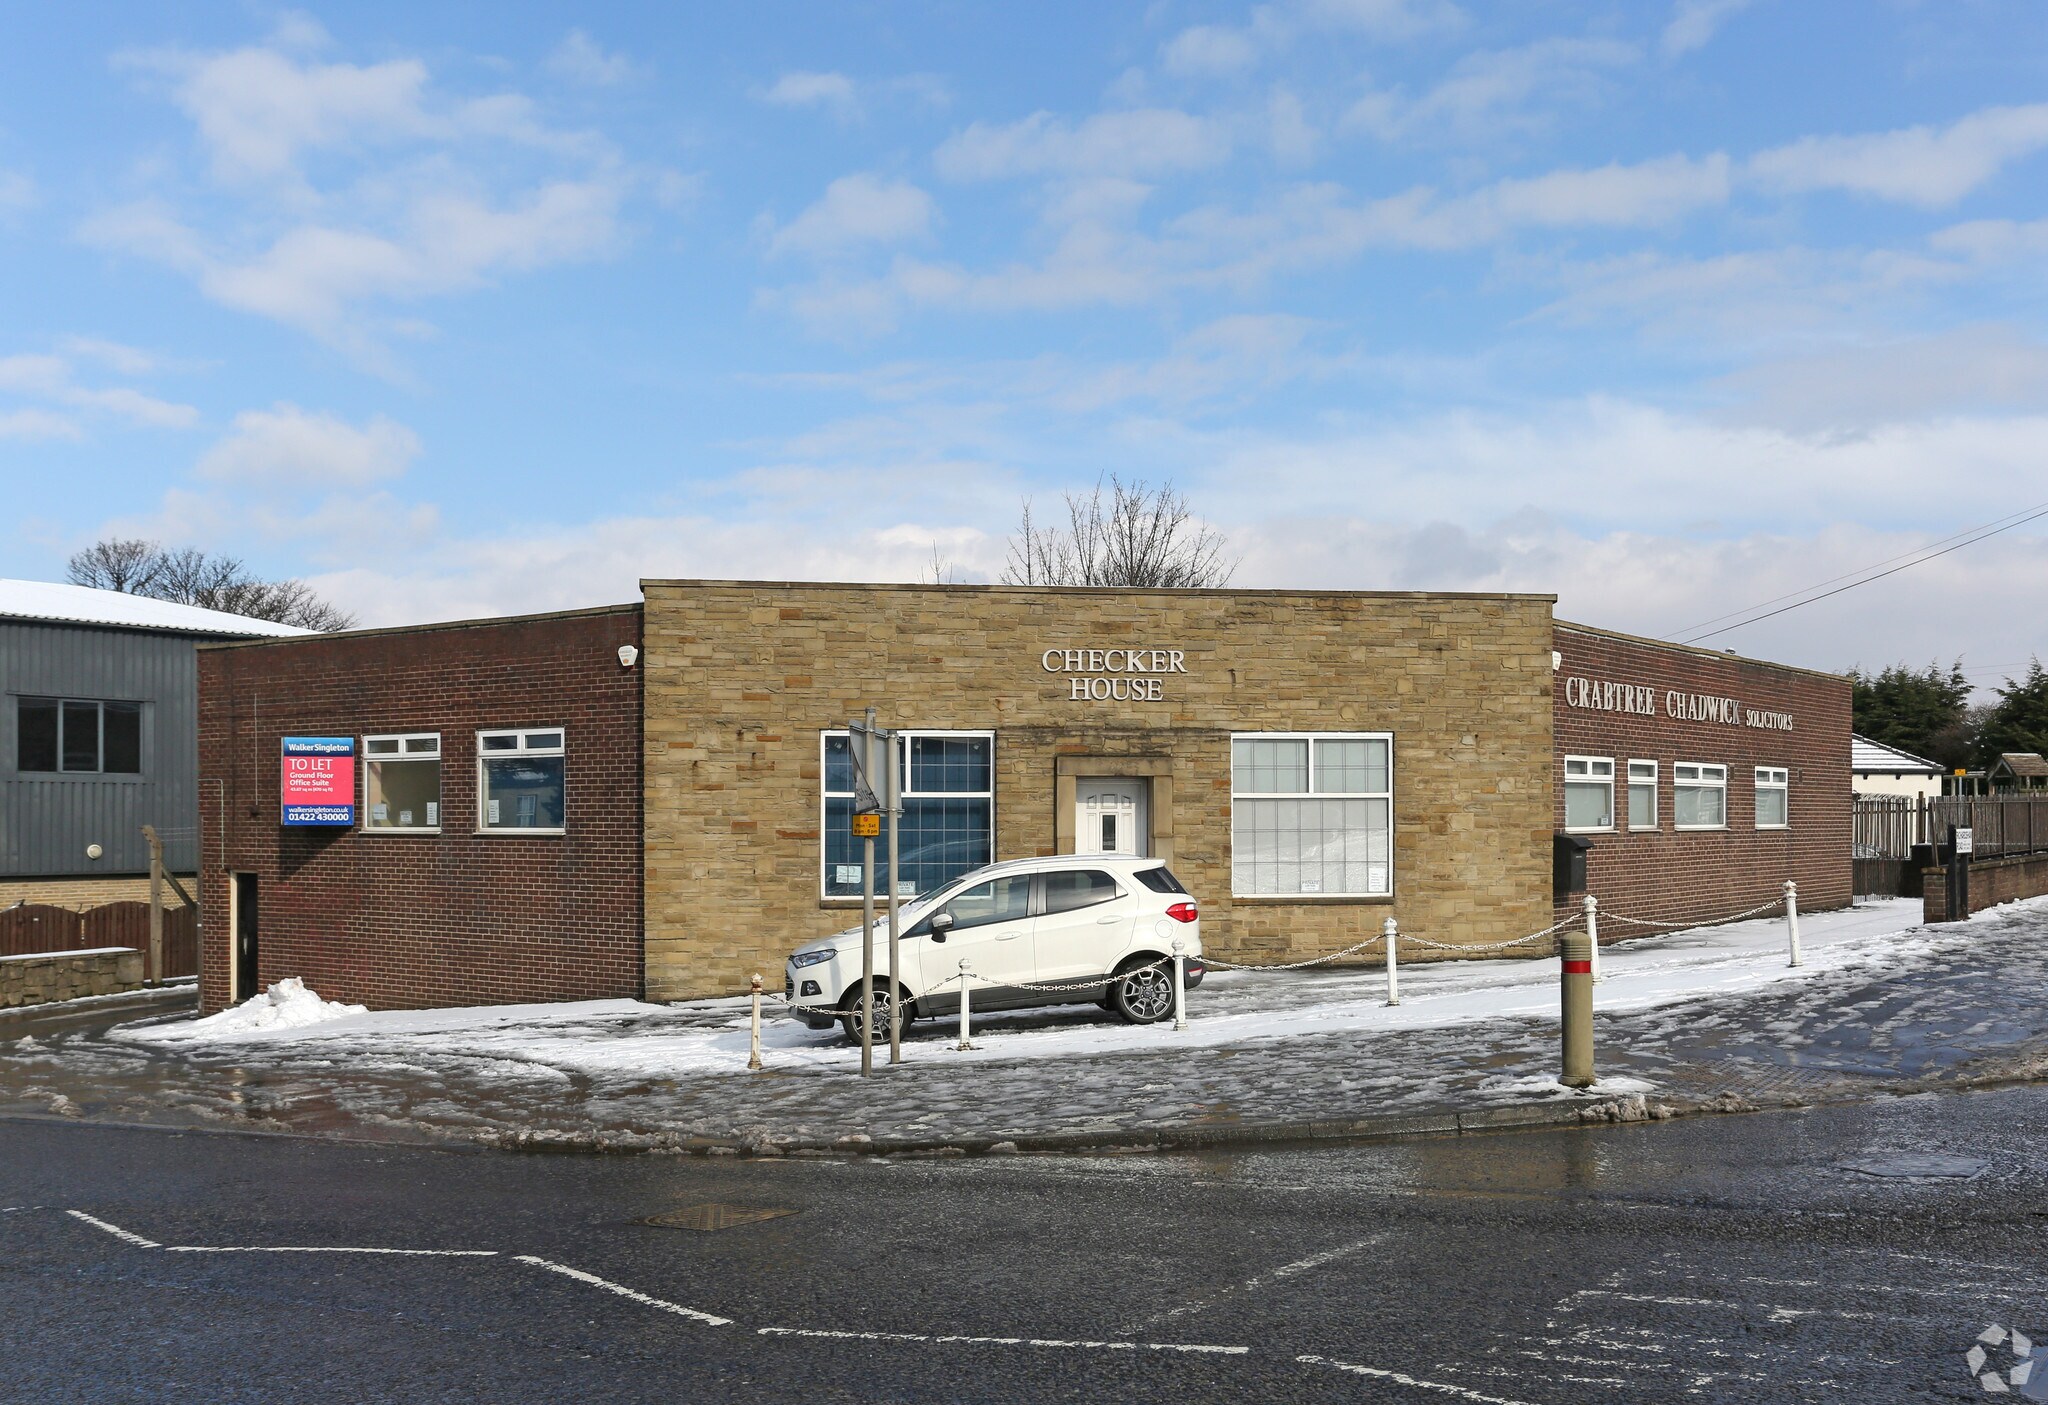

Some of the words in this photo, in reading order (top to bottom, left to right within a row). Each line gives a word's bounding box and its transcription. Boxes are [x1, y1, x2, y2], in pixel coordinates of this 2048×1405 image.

[1042, 649, 1188, 673] CHECKER
[1069, 677, 1164, 701] HOUSE
[1565, 676, 1656, 716] CRABTREE
[1665, 690, 1742, 726] CHADWICK
[1746, 708, 1793, 732] SOLICITORS
[289, 758, 308, 770] TO
[311, 758, 334, 770] LET
[288, 806, 349, 814] walkersingleton.co.uk
[288, 813, 316, 821] 01422
[316, 813, 349, 821] 430000
